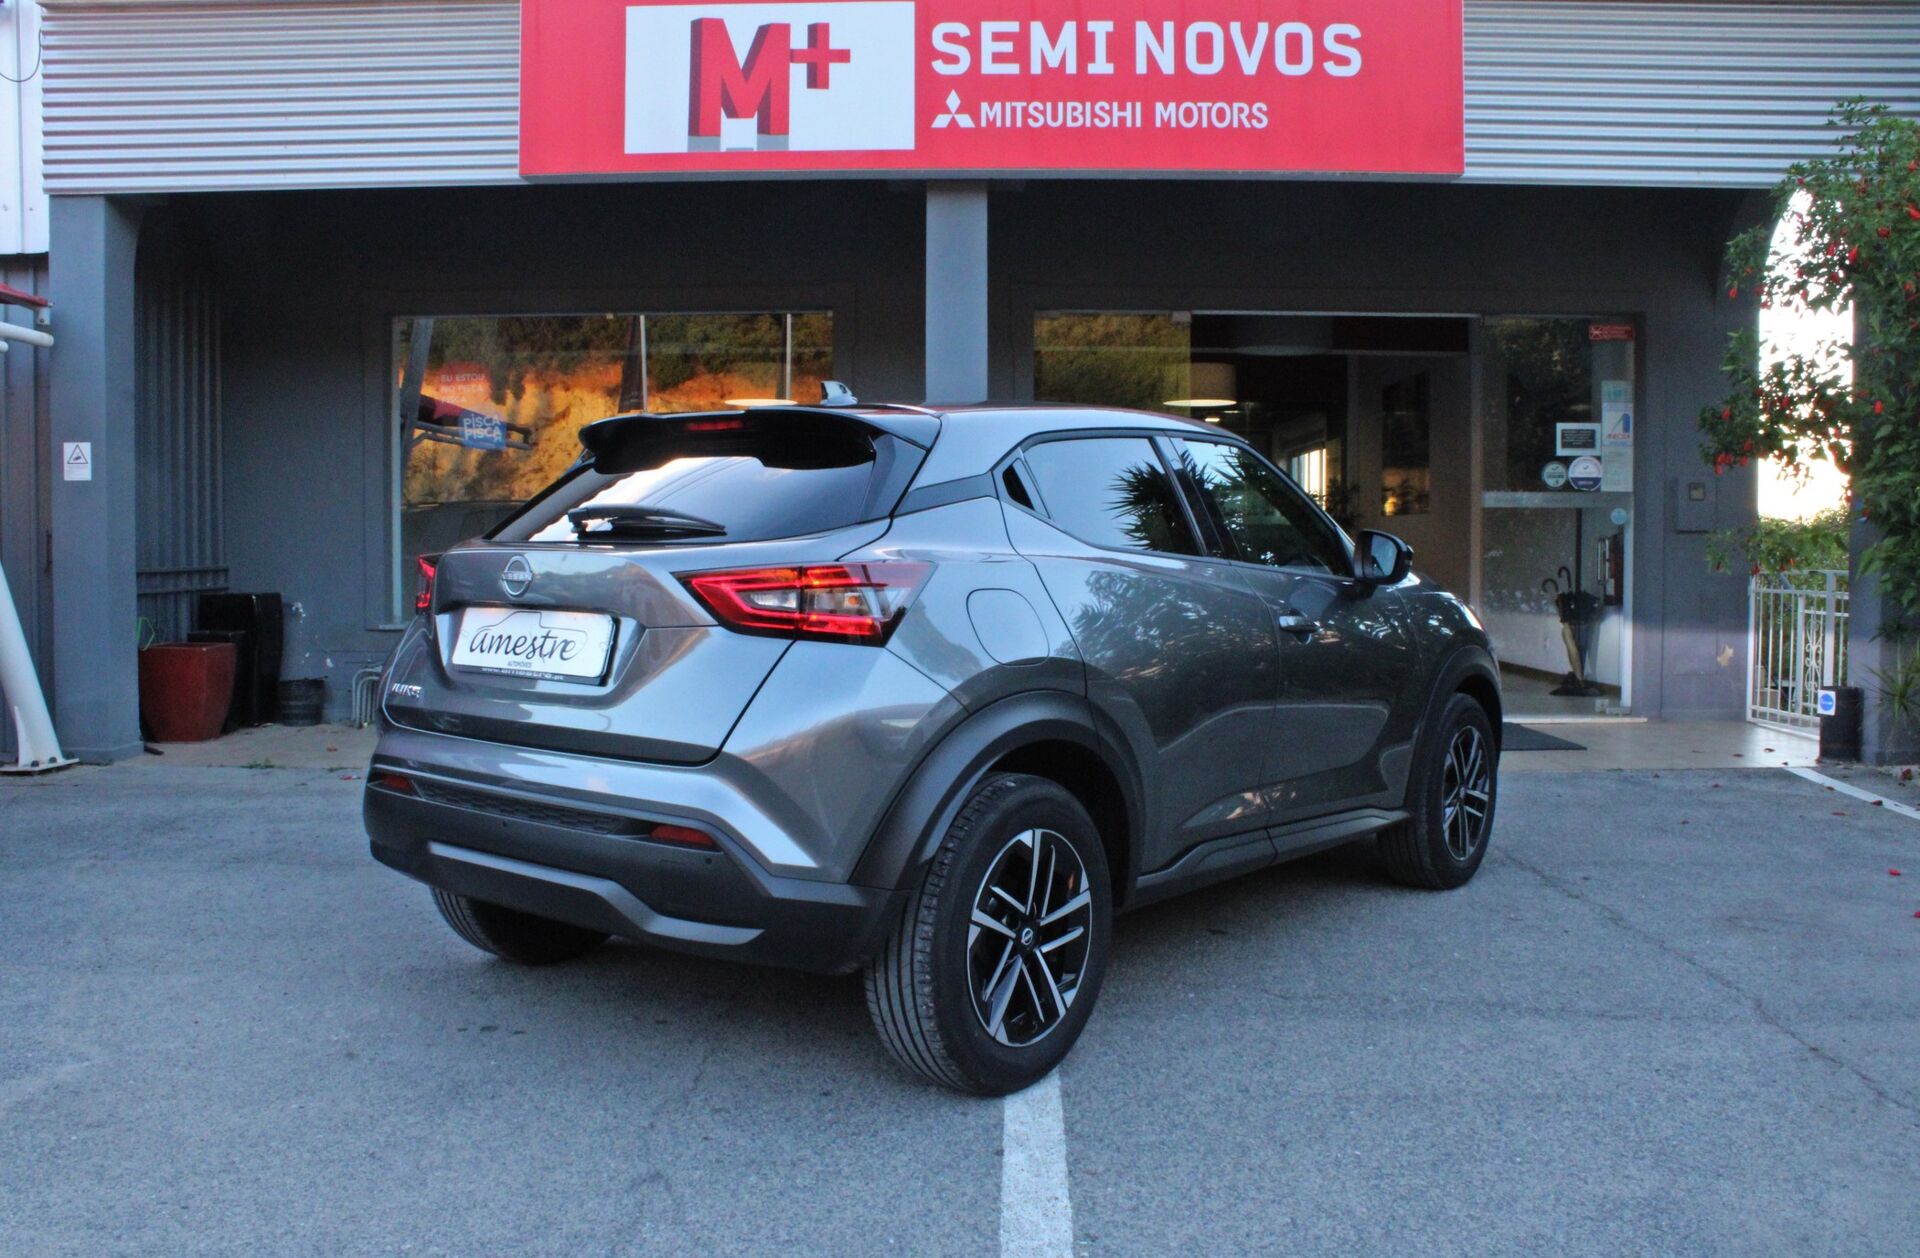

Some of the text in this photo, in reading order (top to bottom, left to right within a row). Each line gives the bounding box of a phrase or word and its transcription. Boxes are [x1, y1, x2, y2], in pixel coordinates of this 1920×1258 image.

[931, 20, 1362, 77] SEMI NOVOS
[980, 101, 1269, 129] MITSUBISHI MOTORS
[455, 373, 486, 382] ESTOU
[469, 628, 577, 662] amestre
